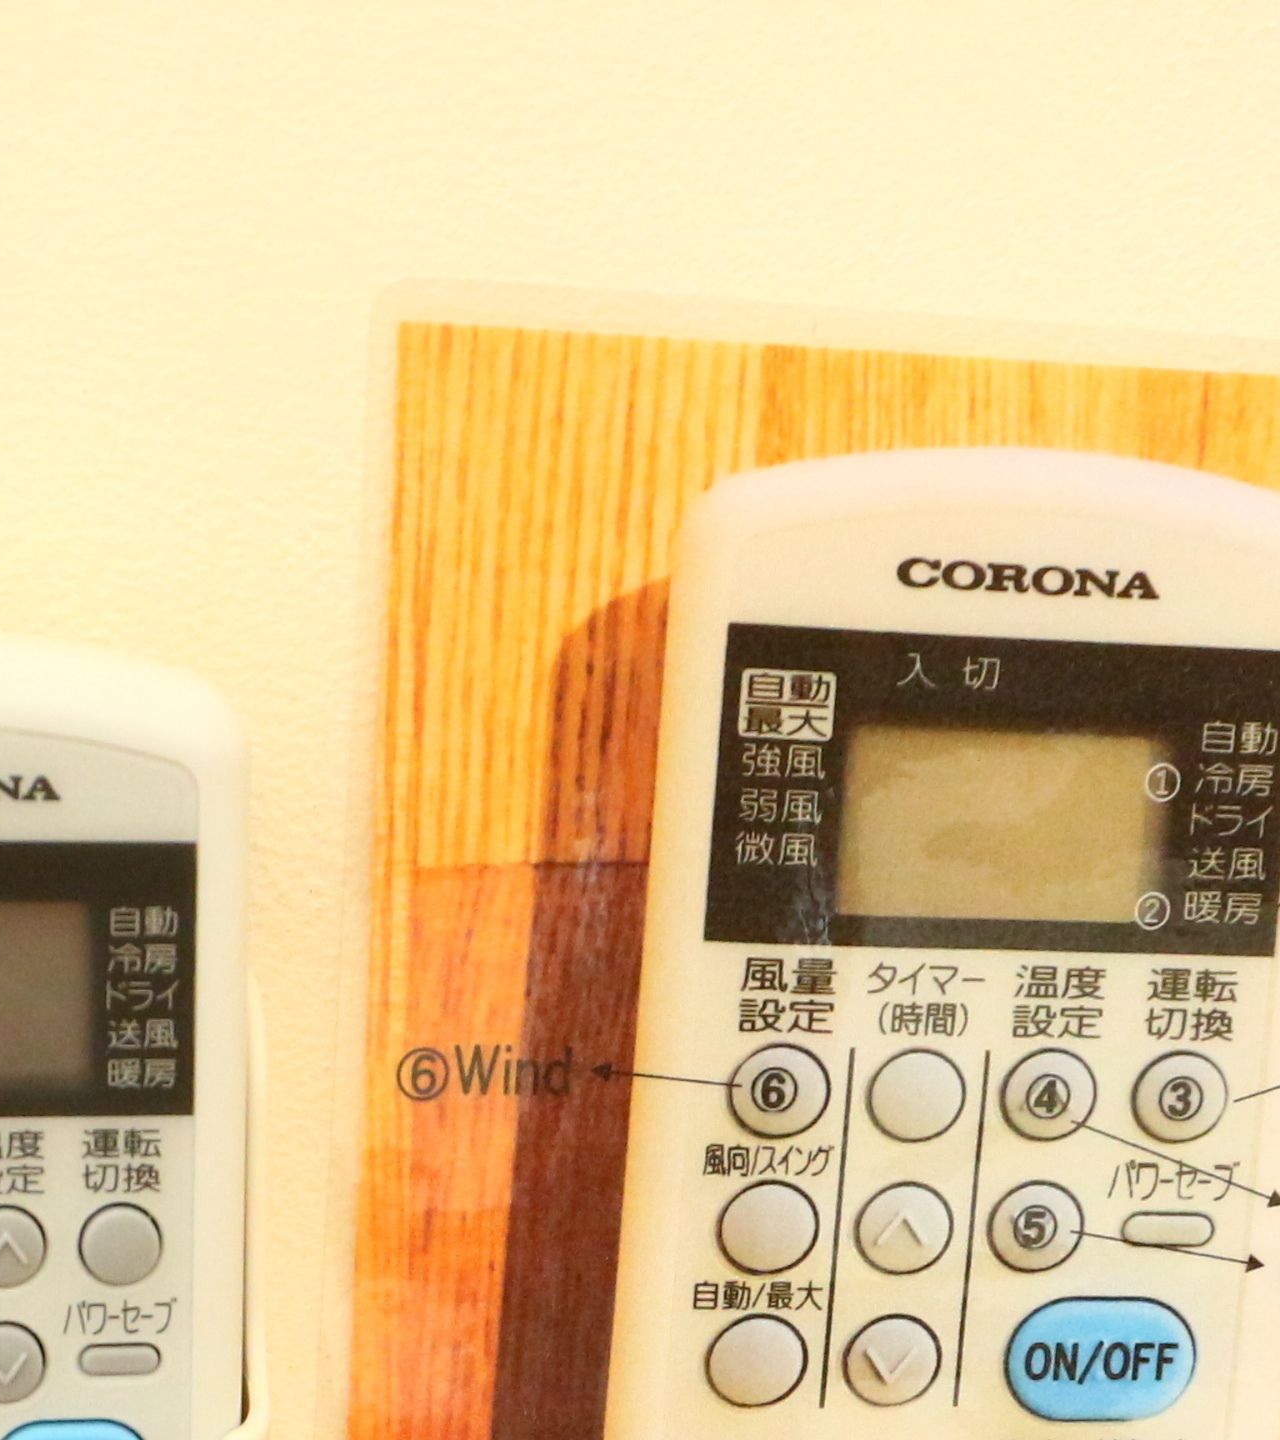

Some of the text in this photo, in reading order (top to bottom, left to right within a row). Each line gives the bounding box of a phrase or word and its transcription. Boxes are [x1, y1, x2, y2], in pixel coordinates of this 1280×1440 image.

[897, 557, 1160, 600] CORONA
[747, 672, 830, 702] 自動
[898, 653, 1002, 690] 入 切
[745, 706, 828, 737] 最大
[1201, 721, 1279, 757] 自動
[742, 743, 825, 780] 強風
[1195, 763, 1274, 798] 冷房
[739, 788, 823, 825] 弱風
[1189, 805, 1273, 839] ドライ
[736, 832, 818, 868] 微風
[1188, 847, 1266, 882] 送風
[108, 905, 179, 938] 自動
[1184, 891, 1261, 927] 暖房
[106, 942, 179, 974] 冷房
[740, 957, 839, 996] 風量
[867, 962, 986, 998] タイマー
[1016, 965, 1107, 1001] 温度
[1147, 968, 1238, 1004] 運転
[106, 981, 180, 1012] ドライ
[107, 1018, 179, 1051] 送風
[738, 999, 836, 1035] 設定
[878, 1001, 969, 1038] (時間)
[1012, 1005, 1103, 1040] 設定
[1145, 1007, 1234, 1042] 切換
[107, 1057, 177, 1089] 暖房
[82, 1128, 162, 1159] 運転
[702, 1143, 835, 1179] 風向/スイング
[83, 1162, 161, 1192] 切換
[693, 1281, 823, 1311] 自動/最大
[1024, 1341, 1179, 1386] ON/OFF
